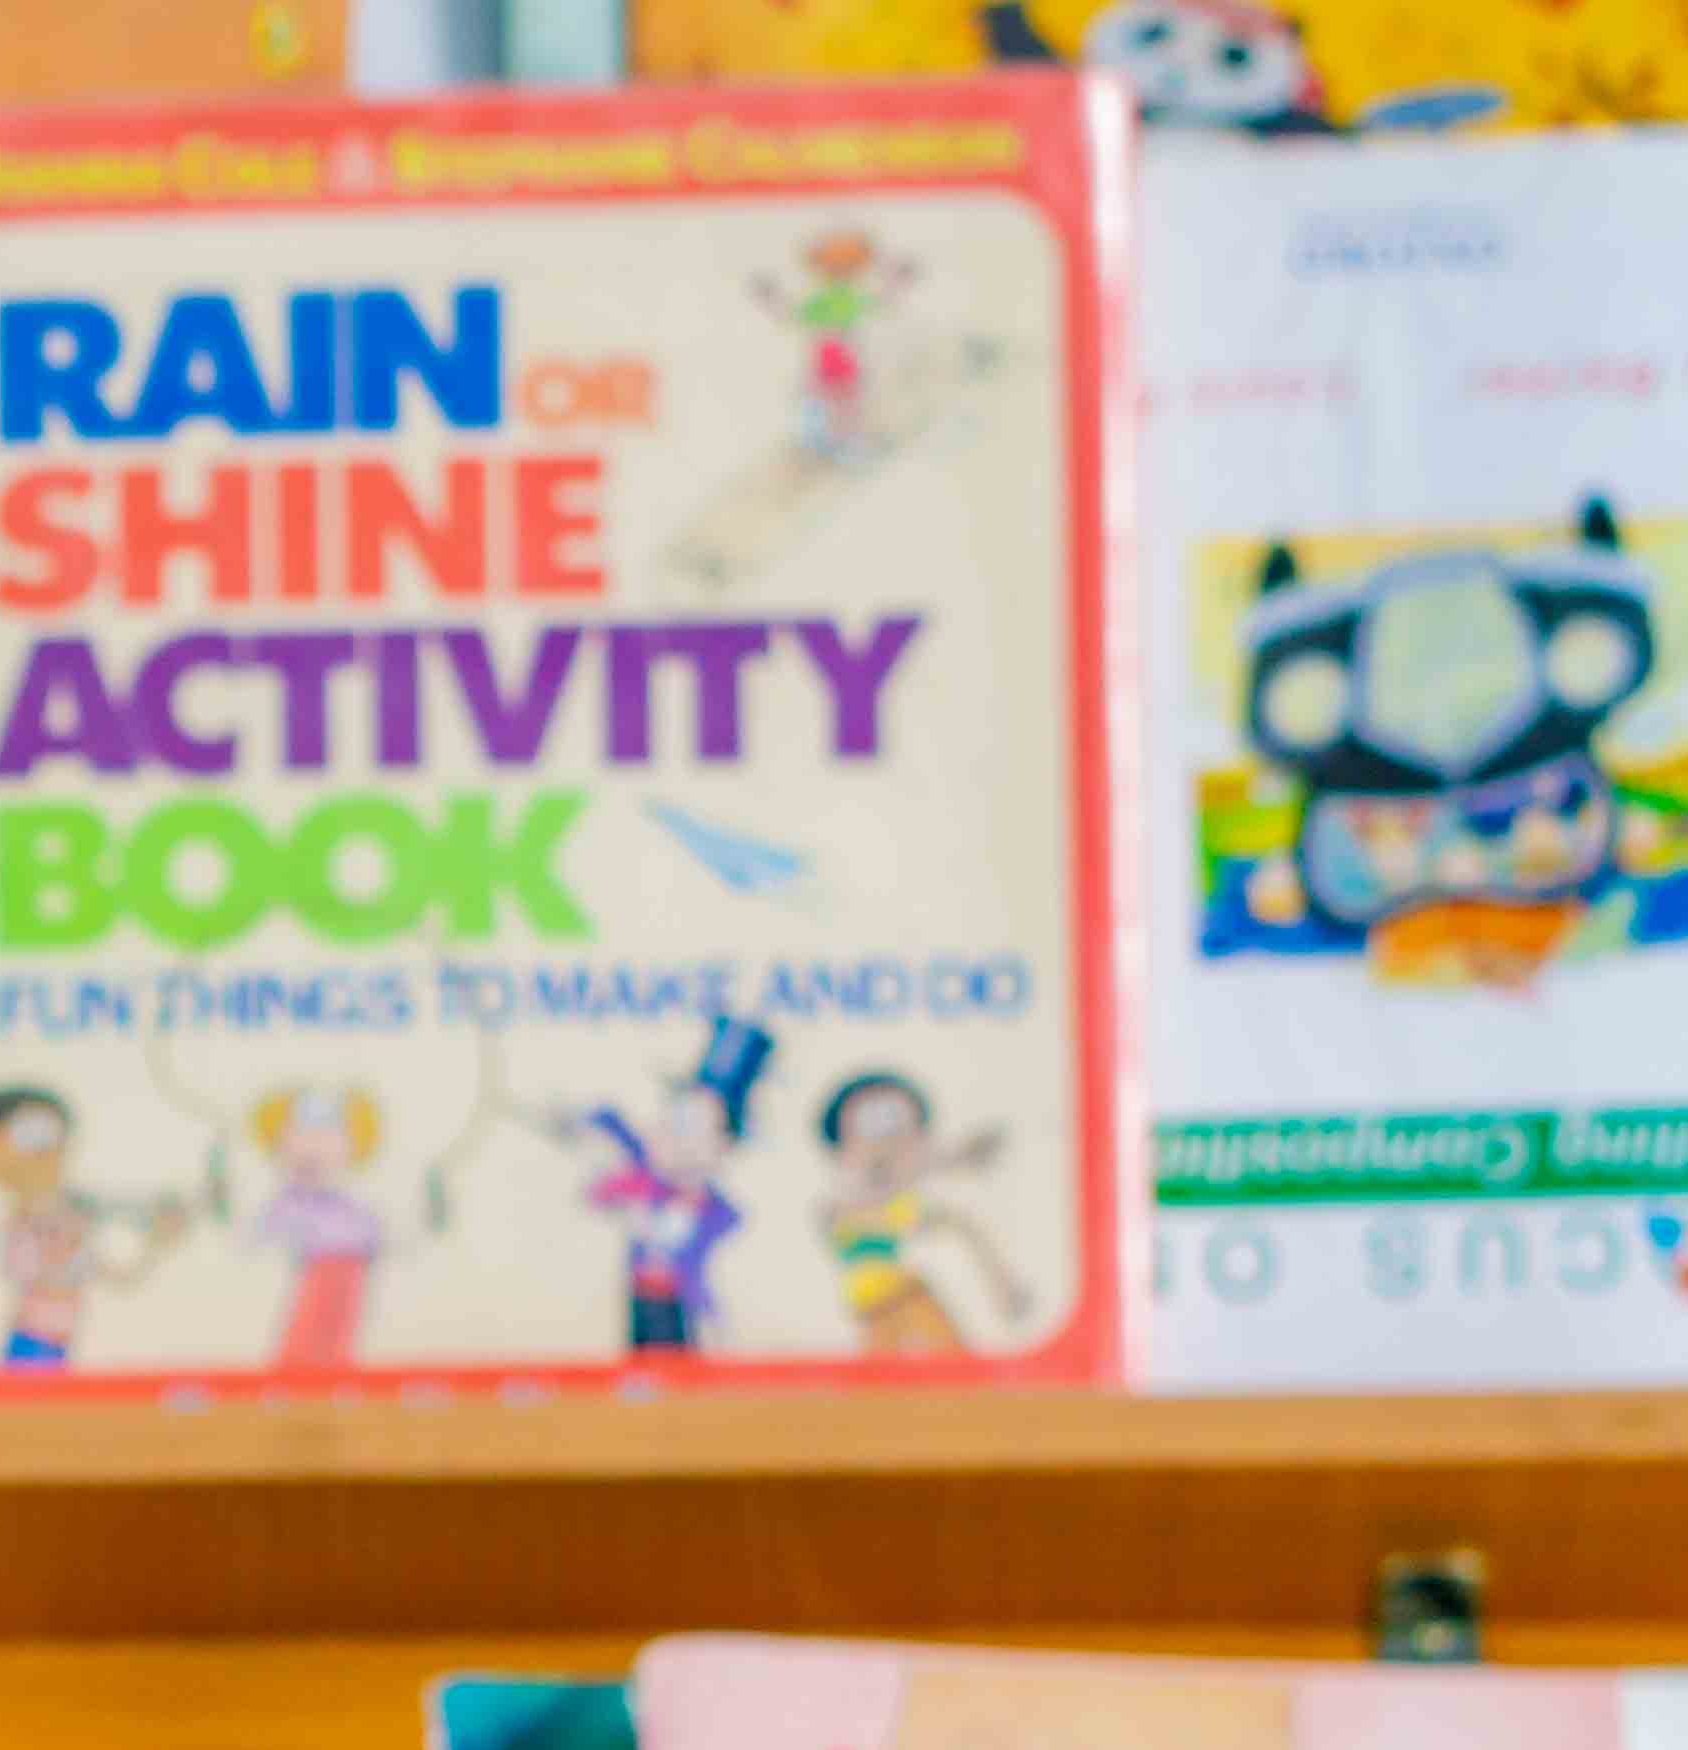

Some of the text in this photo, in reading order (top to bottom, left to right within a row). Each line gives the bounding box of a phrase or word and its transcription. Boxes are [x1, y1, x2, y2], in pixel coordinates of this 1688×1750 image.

[514, 360, 655, 428] OR
[150, 966, 413, 1031] THINGS
[437, 960, 517, 1024] TO
[531, 958, 731, 1020] MAKE
[759, 955, 914, 1019] AND
[924, 953, 1033, 1015] DO
[1155, 1117, 1528, 1184] Compositio
